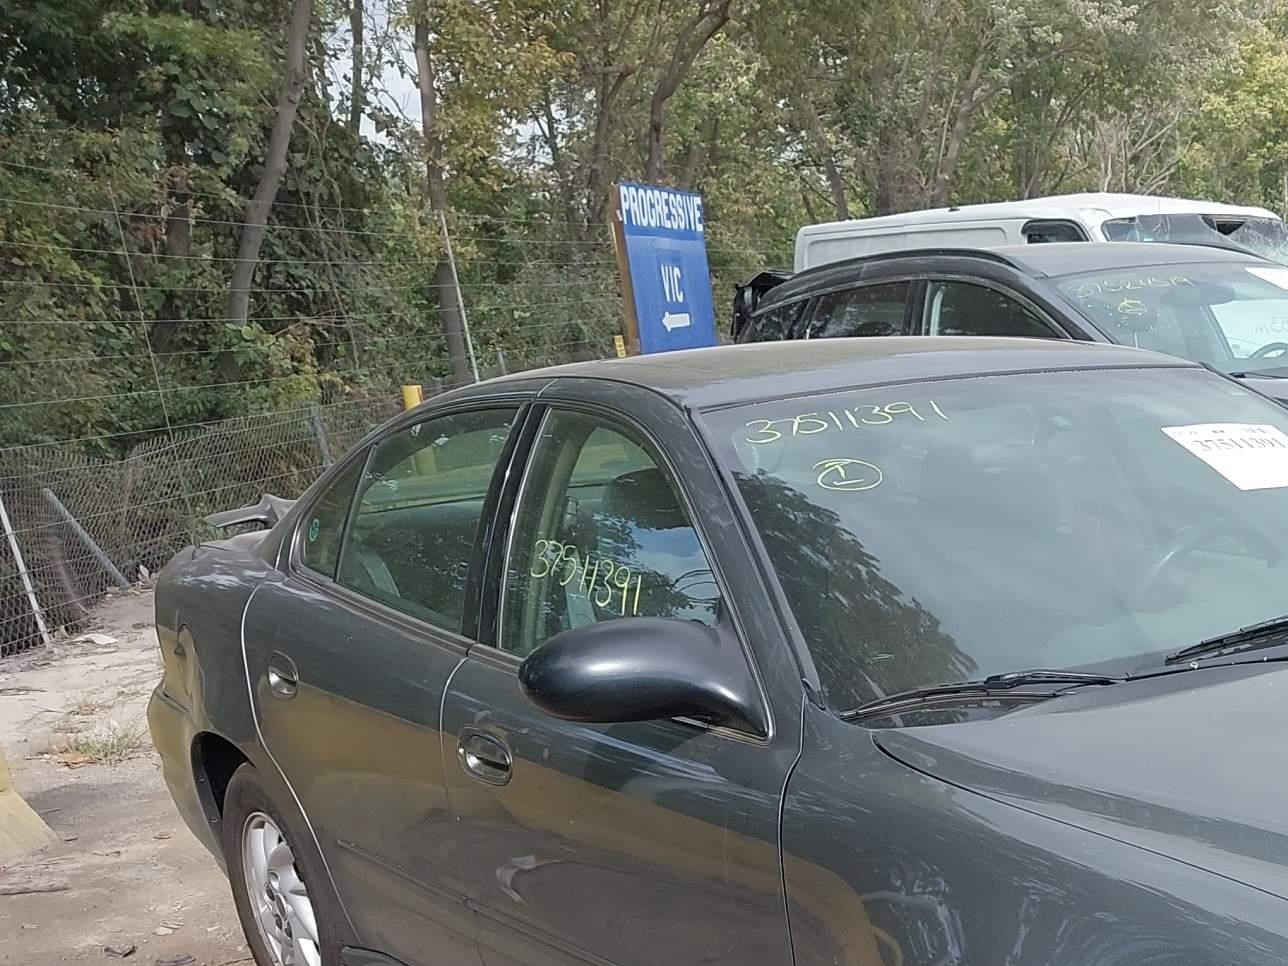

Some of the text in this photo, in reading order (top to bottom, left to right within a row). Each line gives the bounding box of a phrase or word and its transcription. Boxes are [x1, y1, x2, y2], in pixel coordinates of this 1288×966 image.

[619, 186, 704, 232] PROGRESSIVE
[660, 264, 684, 303] VIC
[745, 400, 950, 444] 37511391
[530, 539, 642, 617] 37511391
